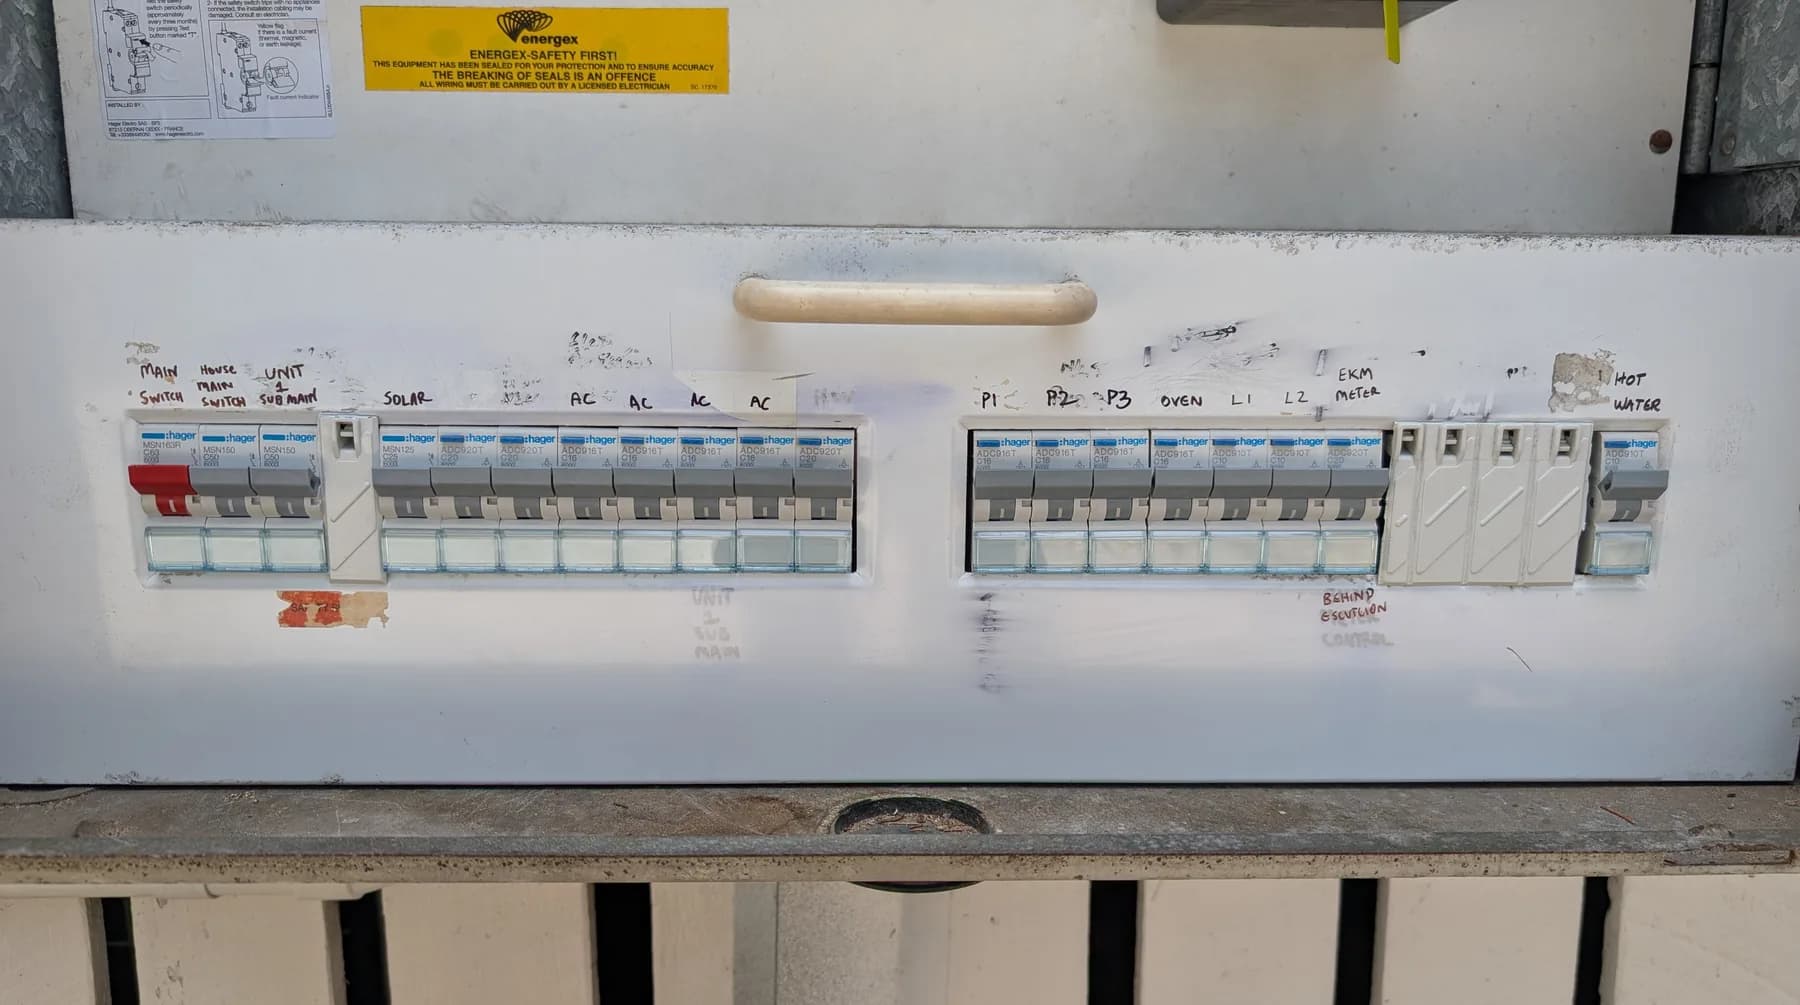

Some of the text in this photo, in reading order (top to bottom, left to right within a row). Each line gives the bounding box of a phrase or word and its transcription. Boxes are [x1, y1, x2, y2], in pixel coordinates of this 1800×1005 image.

[521, 34, 578, 48] energex
[470, 50, 617, 61] ENERGEX-SAFETY FIRST!
[373, 60, 390, 68] THIS
[440, 61, 456, 69] HAS
[458, 61, 480, 69] BEEN
[481, 61, 512, 69] SEALED
[556, 62, 606, 70] PROTECTION
[608, 62, 625, 70] AND
[672, 63, 714, 71] ACCURACY
[432, 71, 656, 82] THE BREAKING OF SEALS IS AN OFFENCE
[419, 80, 434, 88] ALL
[490, 81, 500, 89] BE
[502, 81, 538, 89] CARRIED
[619, 82, 670, 90] ELECTRICIAN
[140, 363, 178, 379] MAIN
[265, 364, 304, 380] UNIT
[1338, 367, 1373, 382] EKM
[1614, 371, 1647, 386] HOT
[197, 381, 234, 392] MAIN
[275, 381, 288, 392] 1
[1335, 386, 1381, 401] METER
[139, 390, 184, 405] SWITCH
[202, 396, 246, 407] SWITCH
[259, 387, 318, 406] SUB MAIN
[383, 390, 433, 406] SOLAR
[570, 391, 597, 406] AC
[629, 394, 653, 411] AC
[690, 392, 711, 407] AC
[750, 395, 771, 411] AC
[982, 391, 997, 409] P1
[1046, 388, 1080, 407] P2
[1107, 389, 1132, 409] P3
[1160, 394, 1203, 407] OVEN
[1614, 397, 1661, 412] WATER
[1323, 588, 1374, 606] BEHIND
